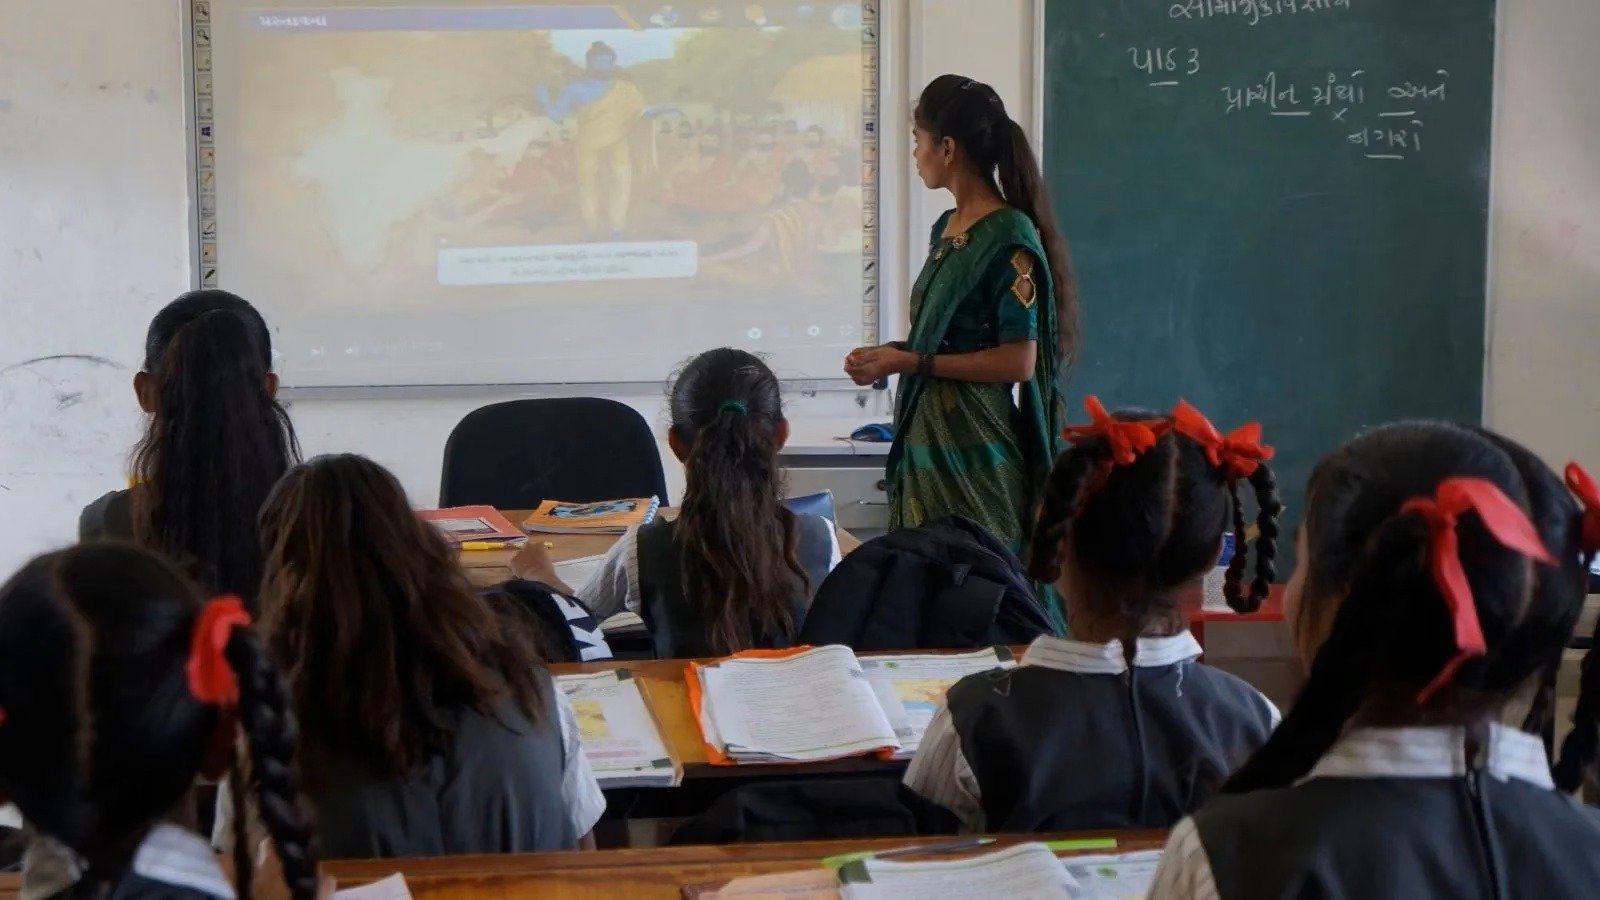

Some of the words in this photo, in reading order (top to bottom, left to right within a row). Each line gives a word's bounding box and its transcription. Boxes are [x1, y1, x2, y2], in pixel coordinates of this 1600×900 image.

[1125, 46, 1177, 74] પાઠ
[1220, 71, 1301, 114] પ્રાચીન
[1387, 69, 1450, 102] અને
[1345, 119, 1424, 151] નગરો
